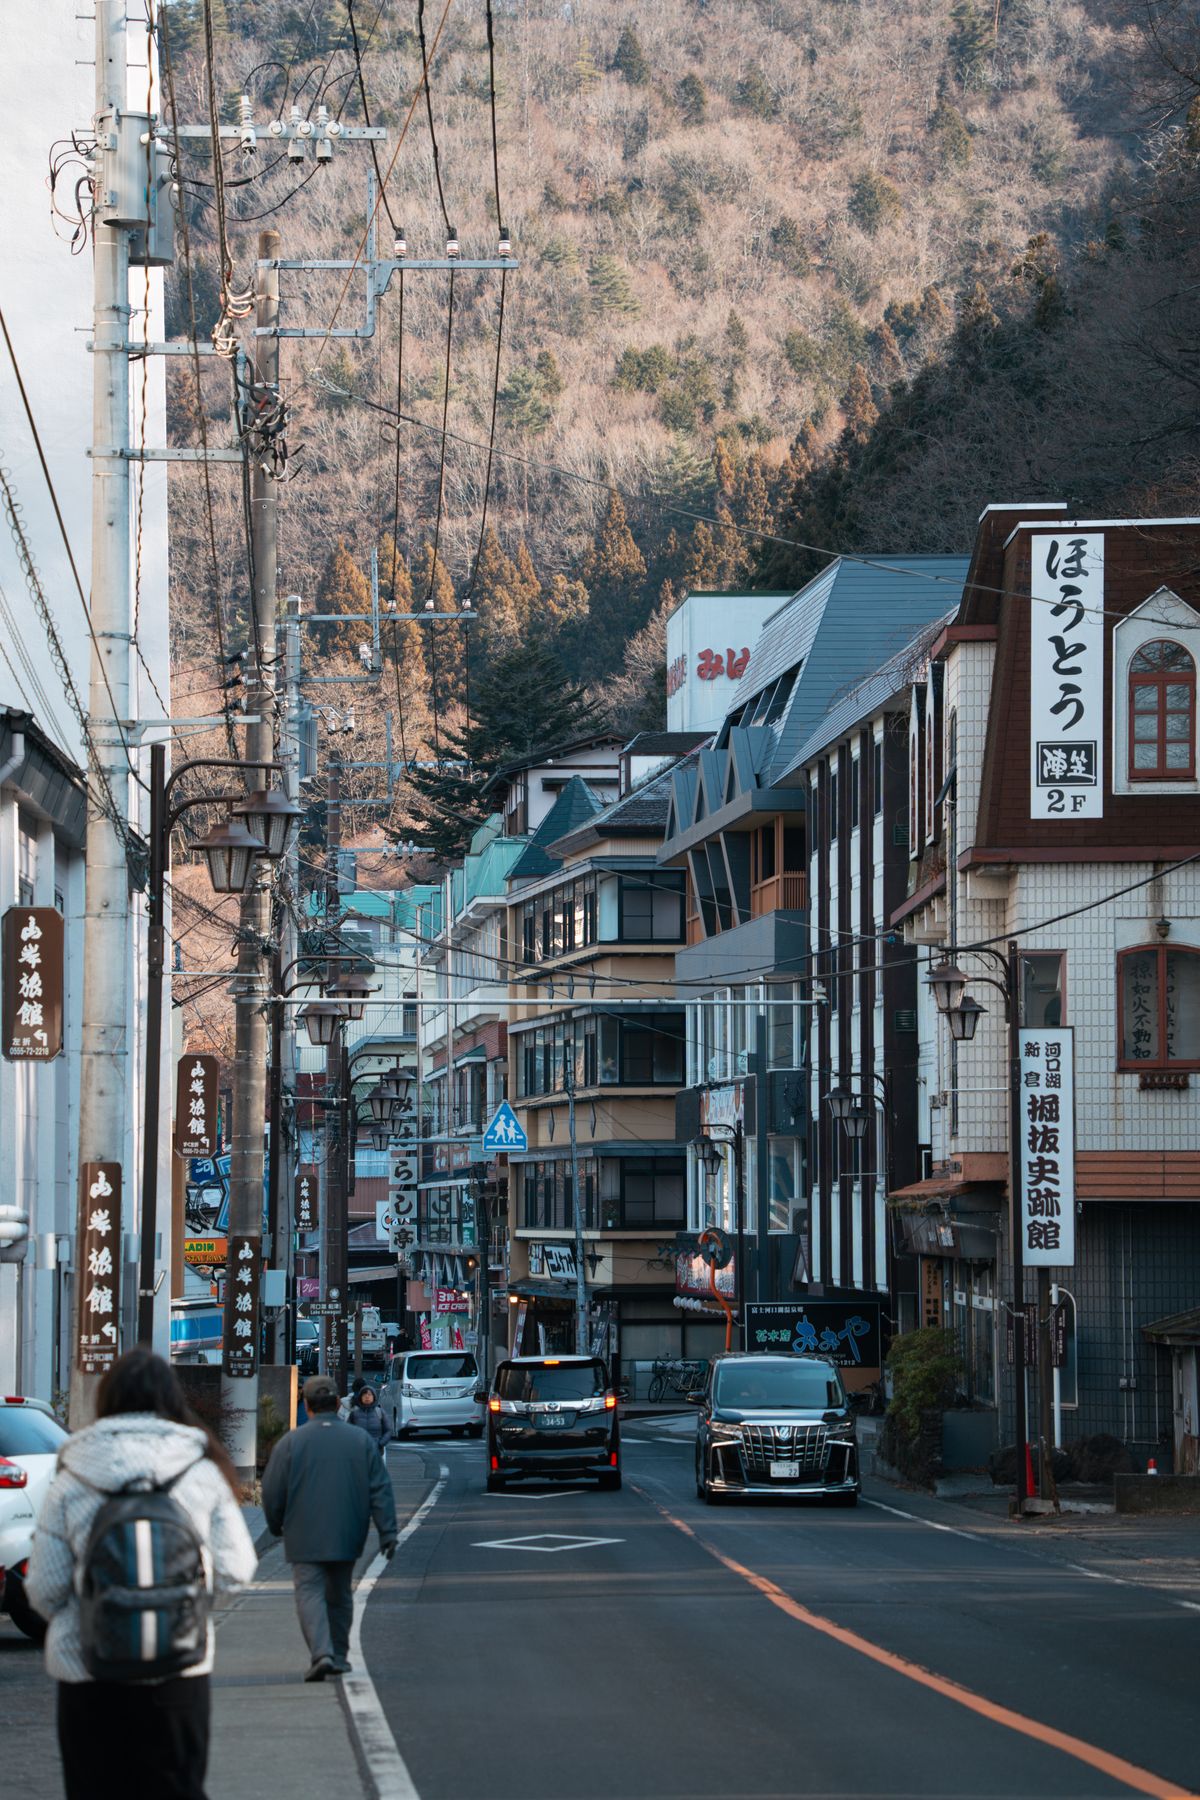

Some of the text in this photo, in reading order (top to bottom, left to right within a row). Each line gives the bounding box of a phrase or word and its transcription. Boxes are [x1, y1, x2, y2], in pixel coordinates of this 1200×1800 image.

[1045, 538, 1090, 732] ほうとう
[16, 915, 43, 1027] 山岸旅館
[12, 1037, 31, 1046] 左折
[1045, 1042, 1061, 1088] 河口湖
[187, 1060, 206, 1135] 山岸旅館
[1027, 1093, 1061, 1250] 掘抜史跡館
[85, 1170, 113, 1314] 山岸旅館
[184, 1242, 215, 1252] ADIN
[233, 1241, 254, 1338] 山岸旅館
[80, 1334, 100, 1344] 左折
[792, 1314, 870, 1362] おおや
